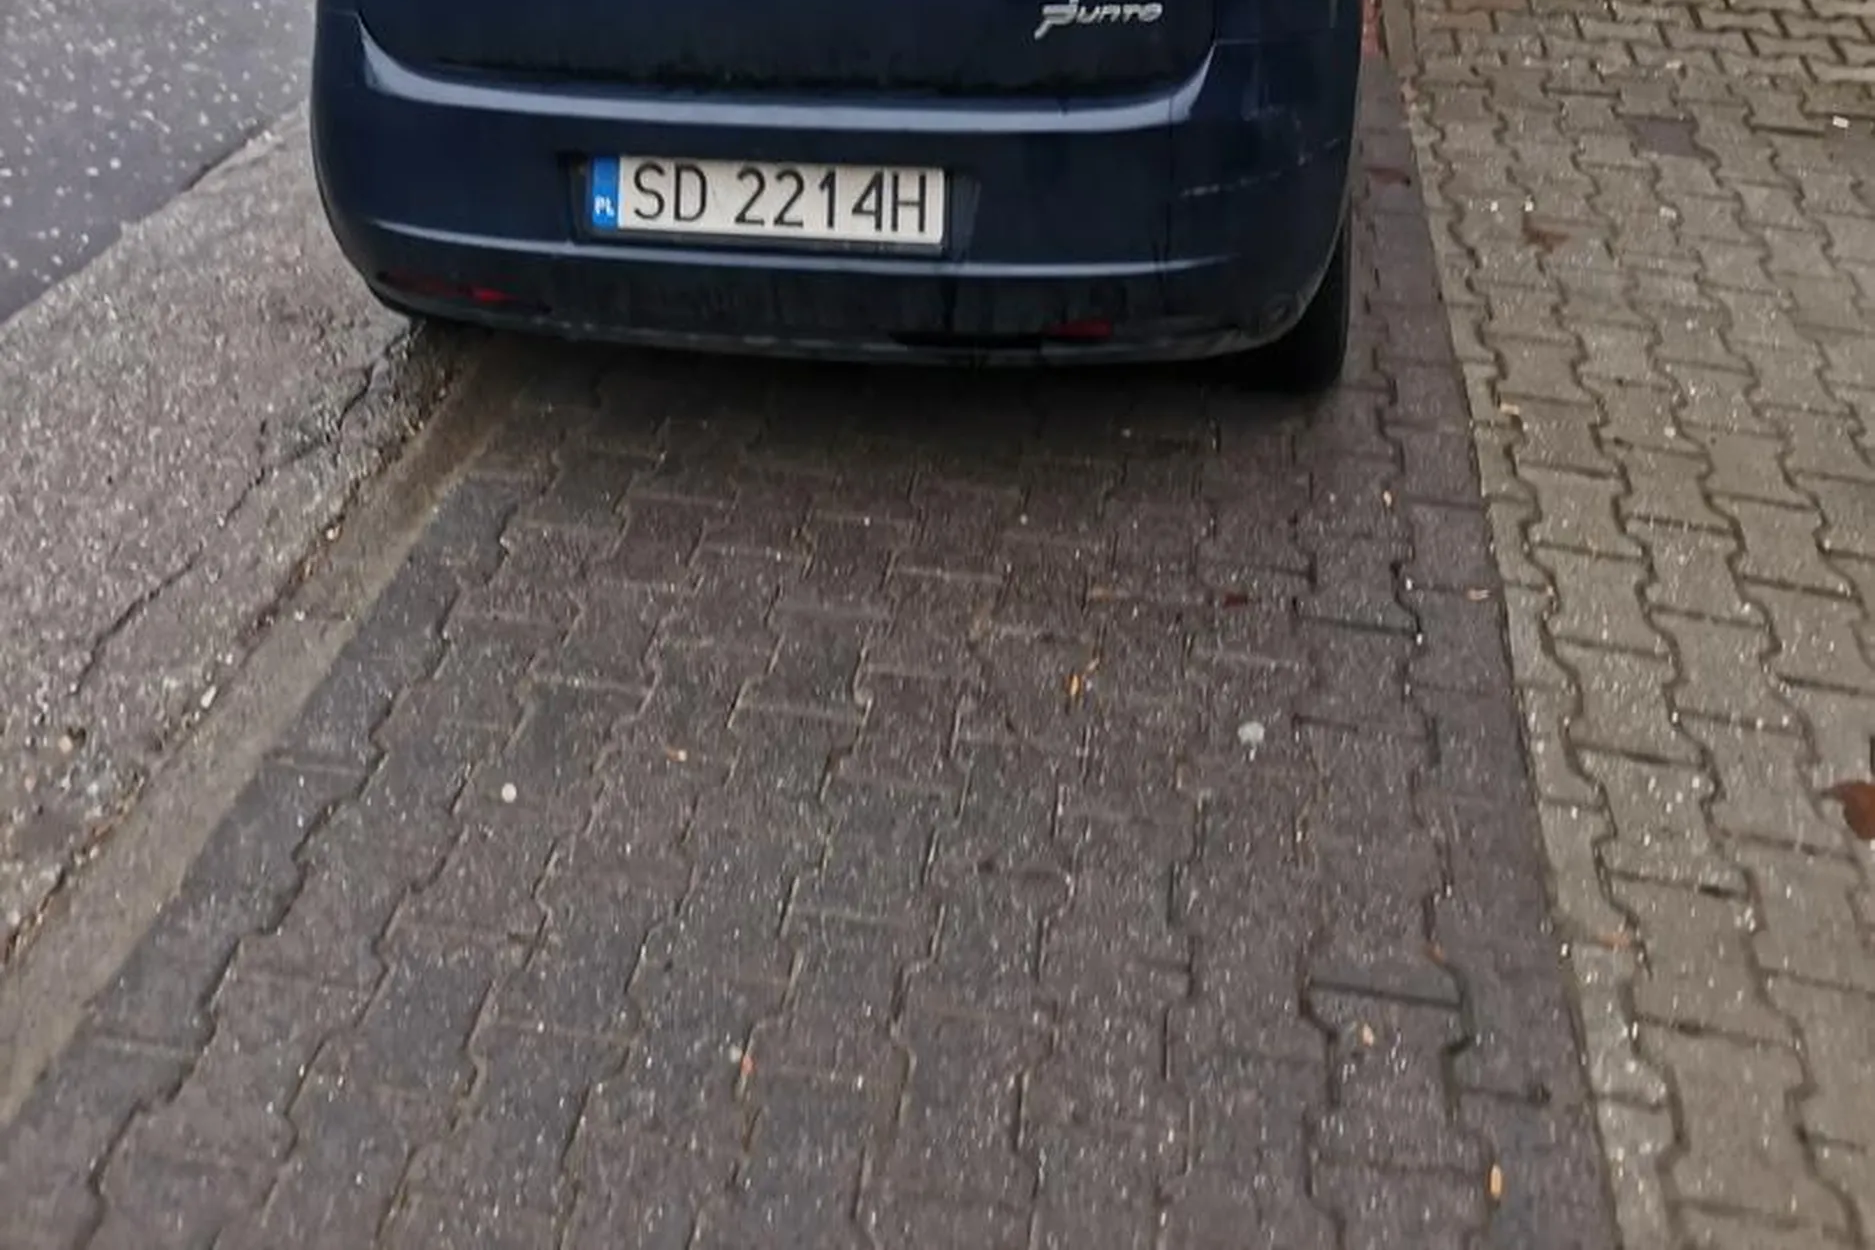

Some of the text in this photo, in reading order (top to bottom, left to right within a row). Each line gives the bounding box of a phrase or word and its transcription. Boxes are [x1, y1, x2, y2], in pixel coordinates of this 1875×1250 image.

[593, 194, 616, 218] PL
[633, 160, 928, 234] SD 2214H
